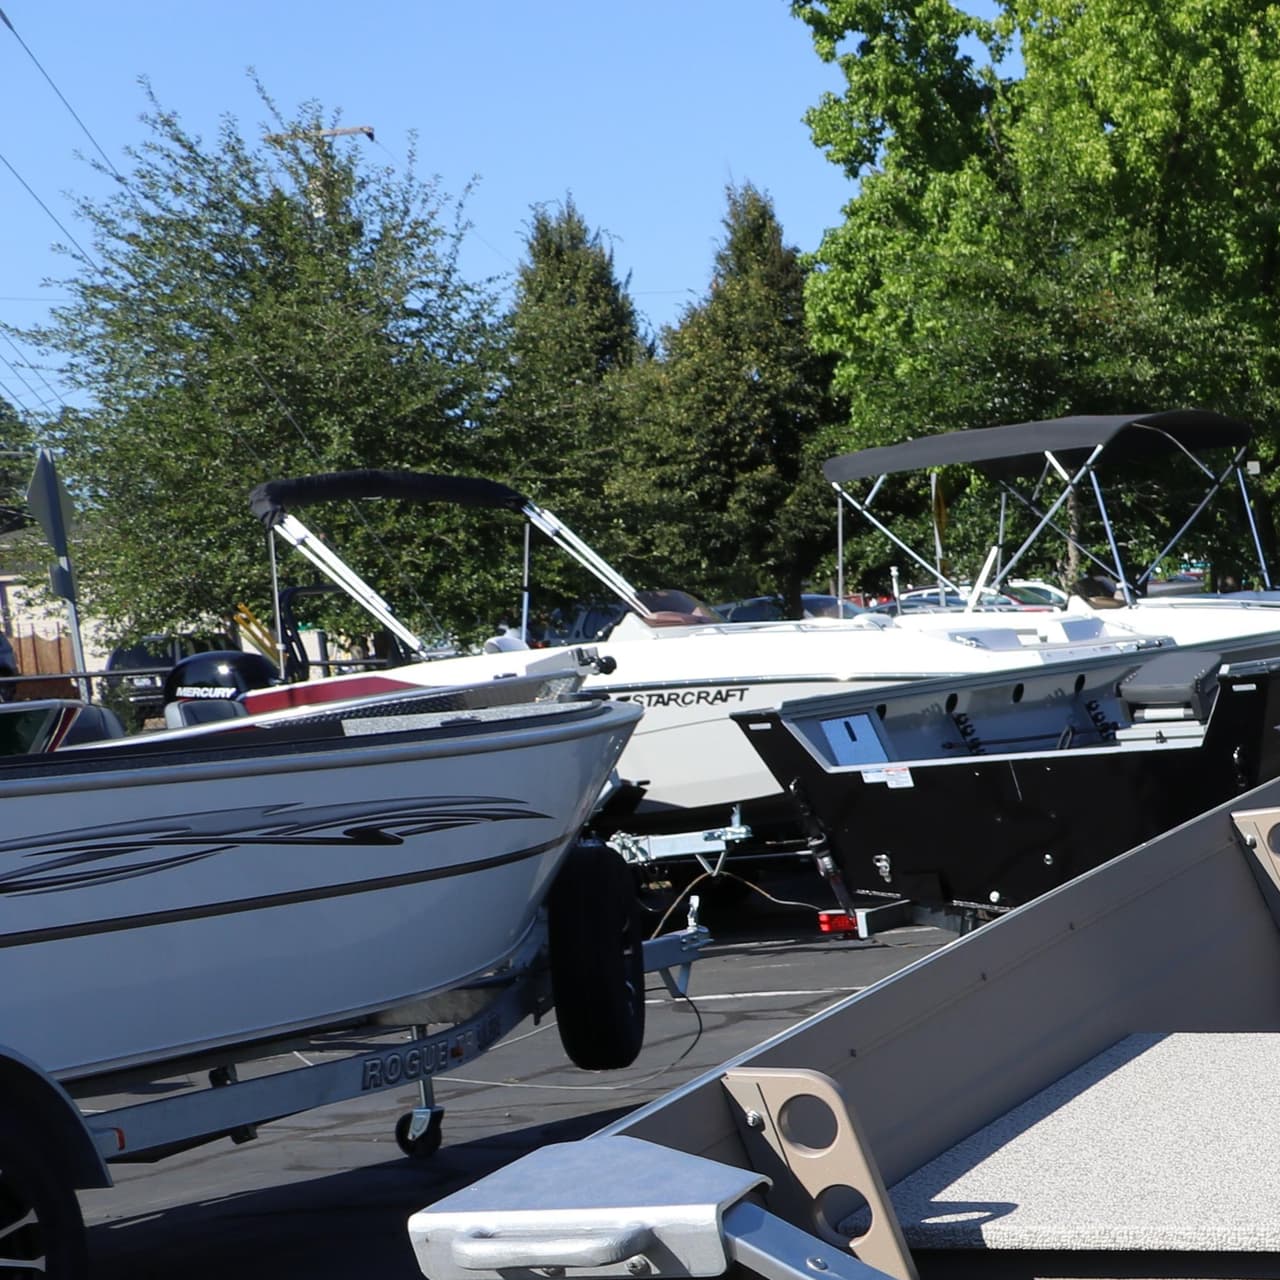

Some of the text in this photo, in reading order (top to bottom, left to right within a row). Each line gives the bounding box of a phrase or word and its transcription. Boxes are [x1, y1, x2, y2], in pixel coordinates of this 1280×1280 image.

[175, 687, 237, 699] MERCURY
[631, 687, 749, 708] STARCRAFT
[361, 1040, 448, 1091] ROGUE
